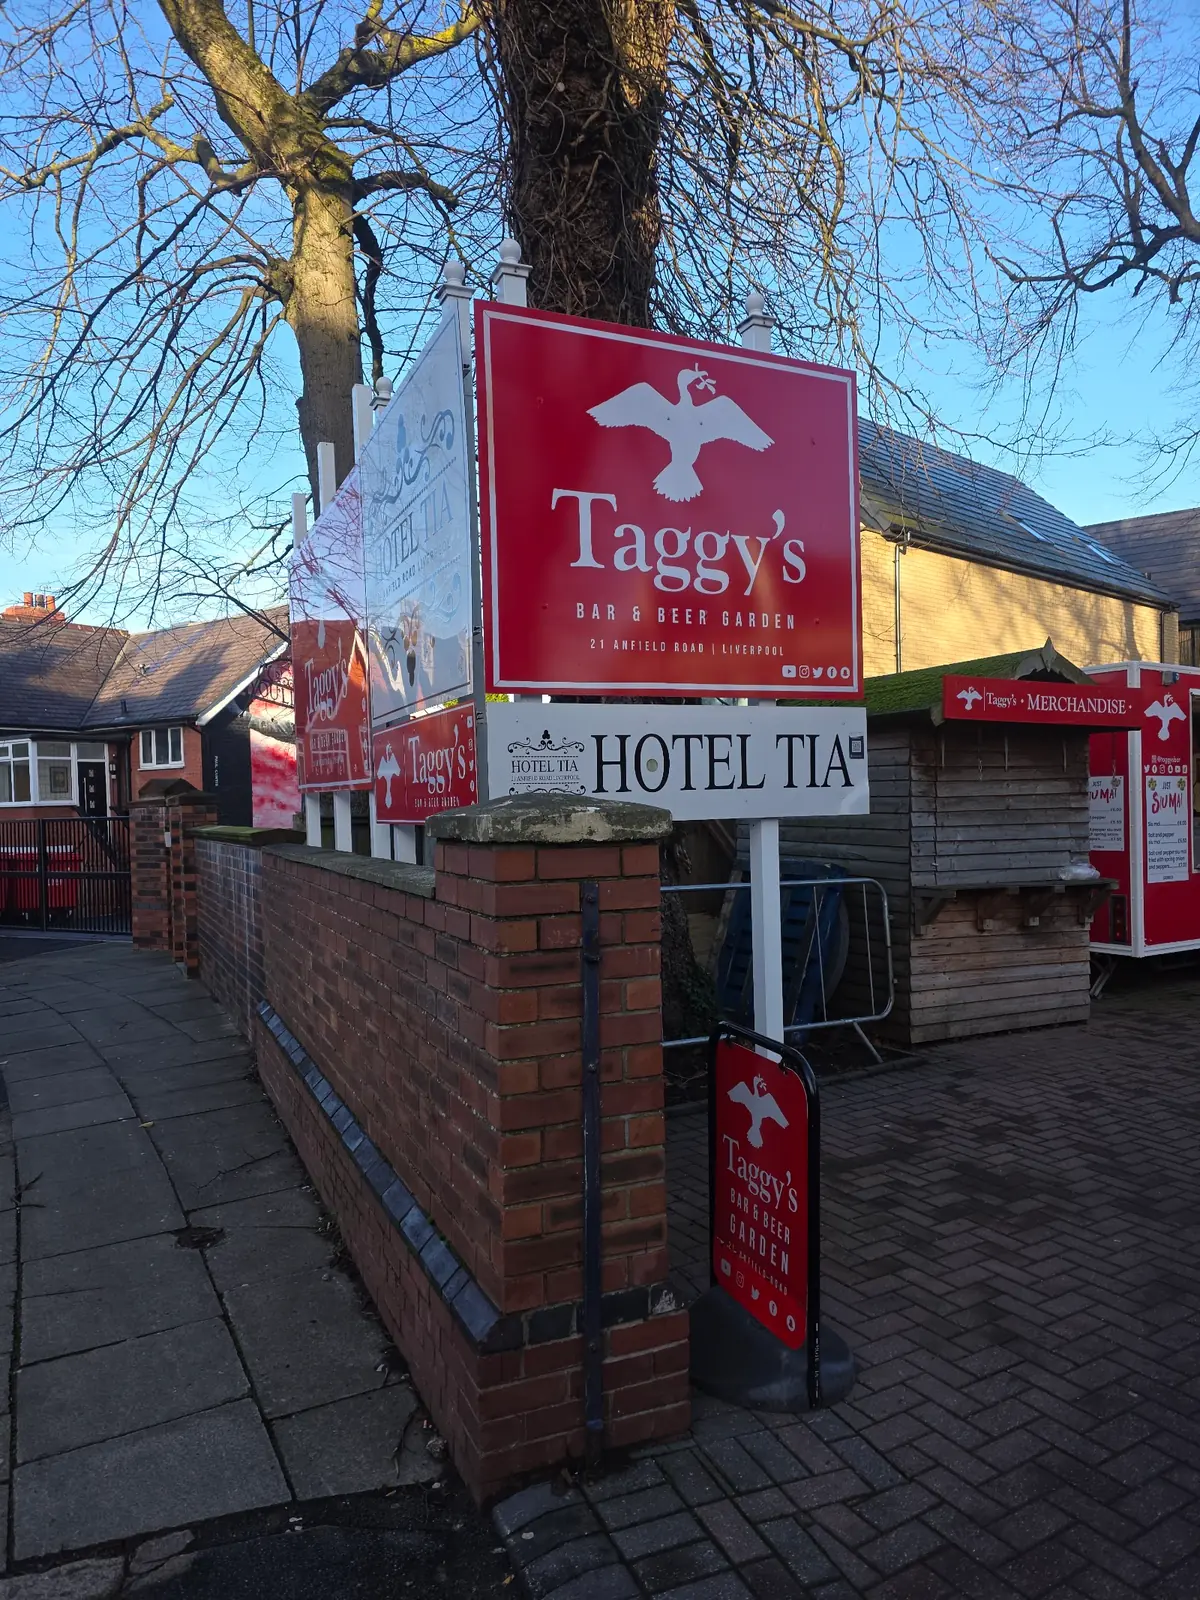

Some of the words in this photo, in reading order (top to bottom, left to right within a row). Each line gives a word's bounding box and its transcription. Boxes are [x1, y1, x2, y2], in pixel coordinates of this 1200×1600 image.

[420, 479, 455, 543] TIA
[551, 488, 807, 597] Taggy's
[576, 602, 616, 621] BAR
[632, 605, 641, 622] &
[657, 607, 708, 625] BEER
[722, 611, 795, 630] GARDEN
[590, 638, 605, 650] 21
[613, 639, 666, 652] ANFIELD
[674, 642, 704, 653] ROAD
[722, 644, 784, 656] LIVERPOOL
[304, 637, 349, 722] Taggy's
[986, 692, 1017, 709] Taggy's
[1027, 693, 1127, 714] MERCHANDISE
[407, 723, 467, 795] Taggy's
[511, 760, 555, 773] HOTEL
[557, 759, 579, 772] TIA
[591, 733, 766, 793] HOTEL
[775, 733, 855, 788] TIA
[1162, 781, 1171, 790] JUST
[722, 1134, 798, 1213] Taggy's
[730, 1187, 749, 1214] BAR
[753, 1204, 759, 1221] &
[763, 1211, 791, 1245] BEER
[730, 1213, 789, 1275] GARDEN
